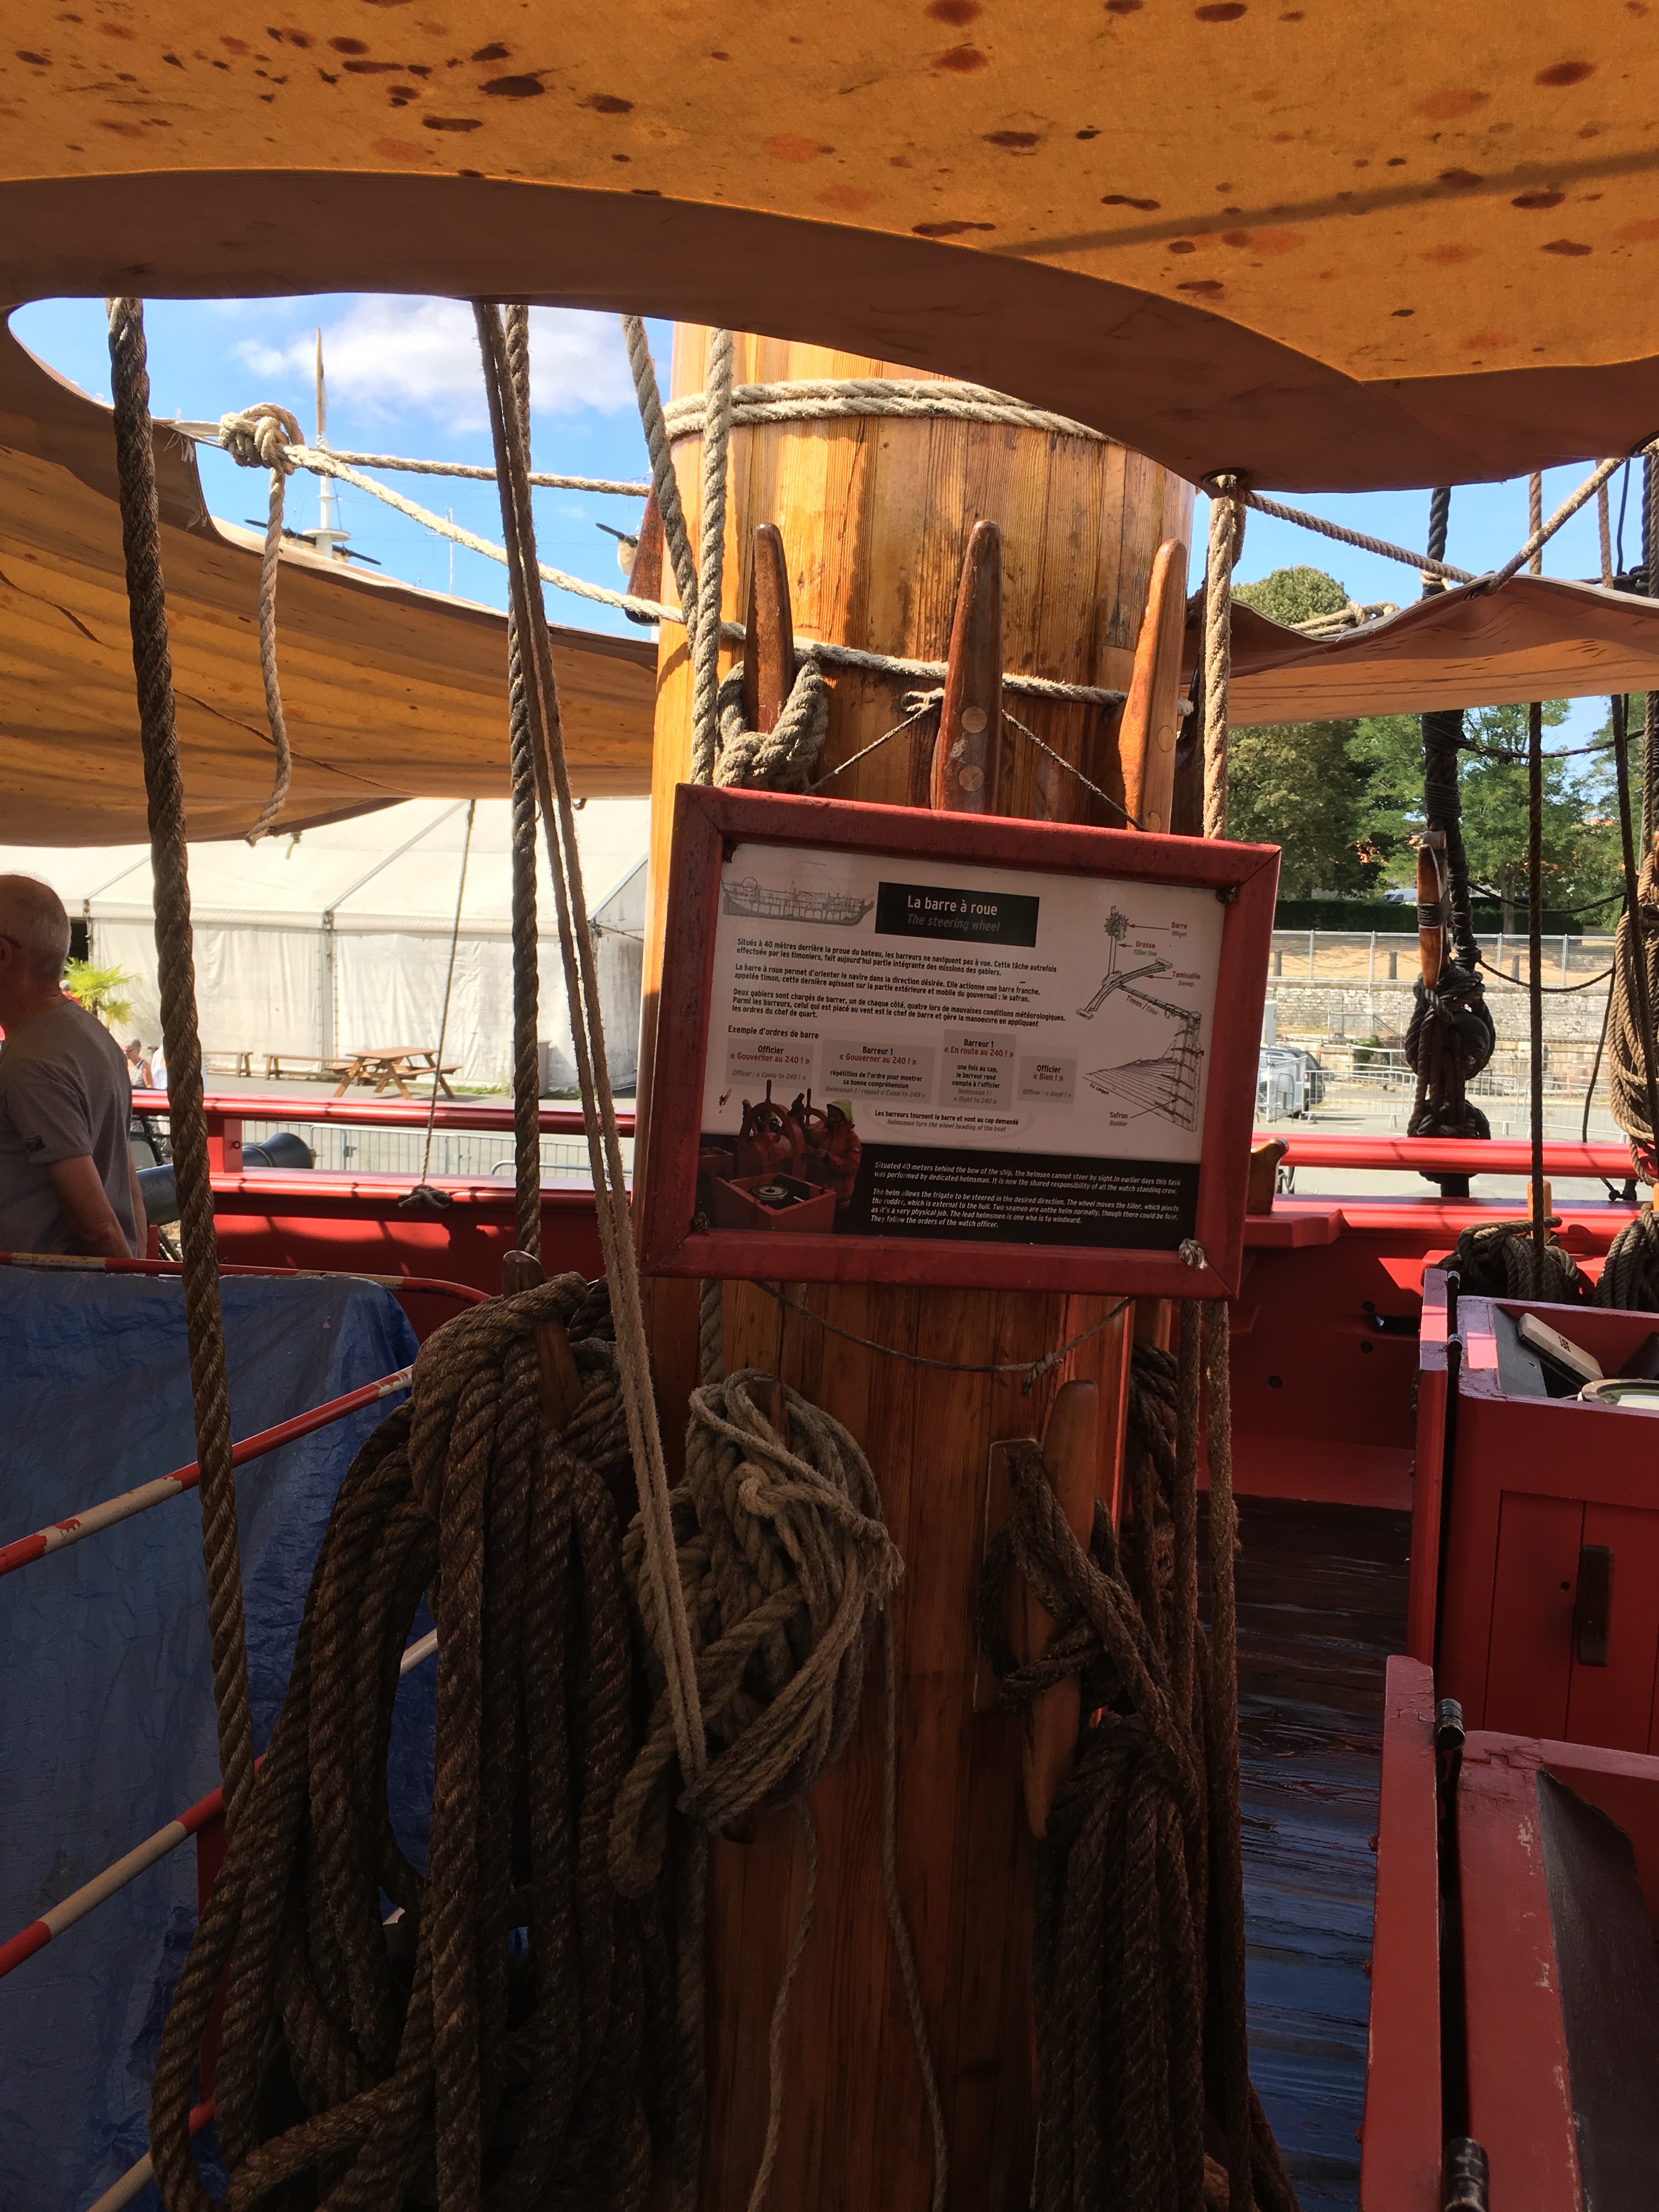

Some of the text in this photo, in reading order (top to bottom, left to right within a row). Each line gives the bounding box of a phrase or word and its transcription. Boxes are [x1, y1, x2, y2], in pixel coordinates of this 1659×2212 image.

[907, 895, 997, 915] La barre à roue
[907, 913, 1001, 932] The steering wheel
[736, 946, 766, 956] effectuée
[791, 951, 822, 961] timoniers,
[837, 955, 871, 964] aujourd'hui
[893, 960, 925, 969] intégrante
[938, 964, 964, 972] missions
[737, 938, 757, 946] Situés
[774, 941, 796, 950] mètres
[798, 943, 823, 952] derrière
[860, 949, 883, 958] bateau,
[895, 952, 921, 961] barreurs
[932, 956, 961, 964] naviguent
[994, 960, 1011, 968] Cette
[1012, 962, 1028, 970] tâche
[1030, 964, 1056, 972] autrefois
[744, 963, 761, 972] barre
[808, 969, 839, 978] d'orienter
[892, 976, 919, 985] direction
[921, 978, 945, 987] désirée.
[958, 982, 985, 990] actionne
[998, 985, 1014, 993] barre
[1016, 986, 1040, 996] franche,
[1172, 970, 1200, 979] Tamisaille
[760, 973, 780, 983] timon,
[800, 977, 827, 985] dernière
[828, 979, 854, 988] agissant
[894, 985, 926, 994] extérieure
[1009, 994, 1029, 1002] safran.
[1127, 995, 1142, 1008] Timon
[727, 1025, 757, 1035] Exemple
[759, 1027, 788, 1037] d'ordres
[800, 1030, 819, 1039] barre
[758, 1045, 784, 1054] Officier
[862, 1046, 888, 1054] Barreur
[737, 1052, 773, 1062] Gouverner
[1036, 1064, 1061, 1073] Officier
